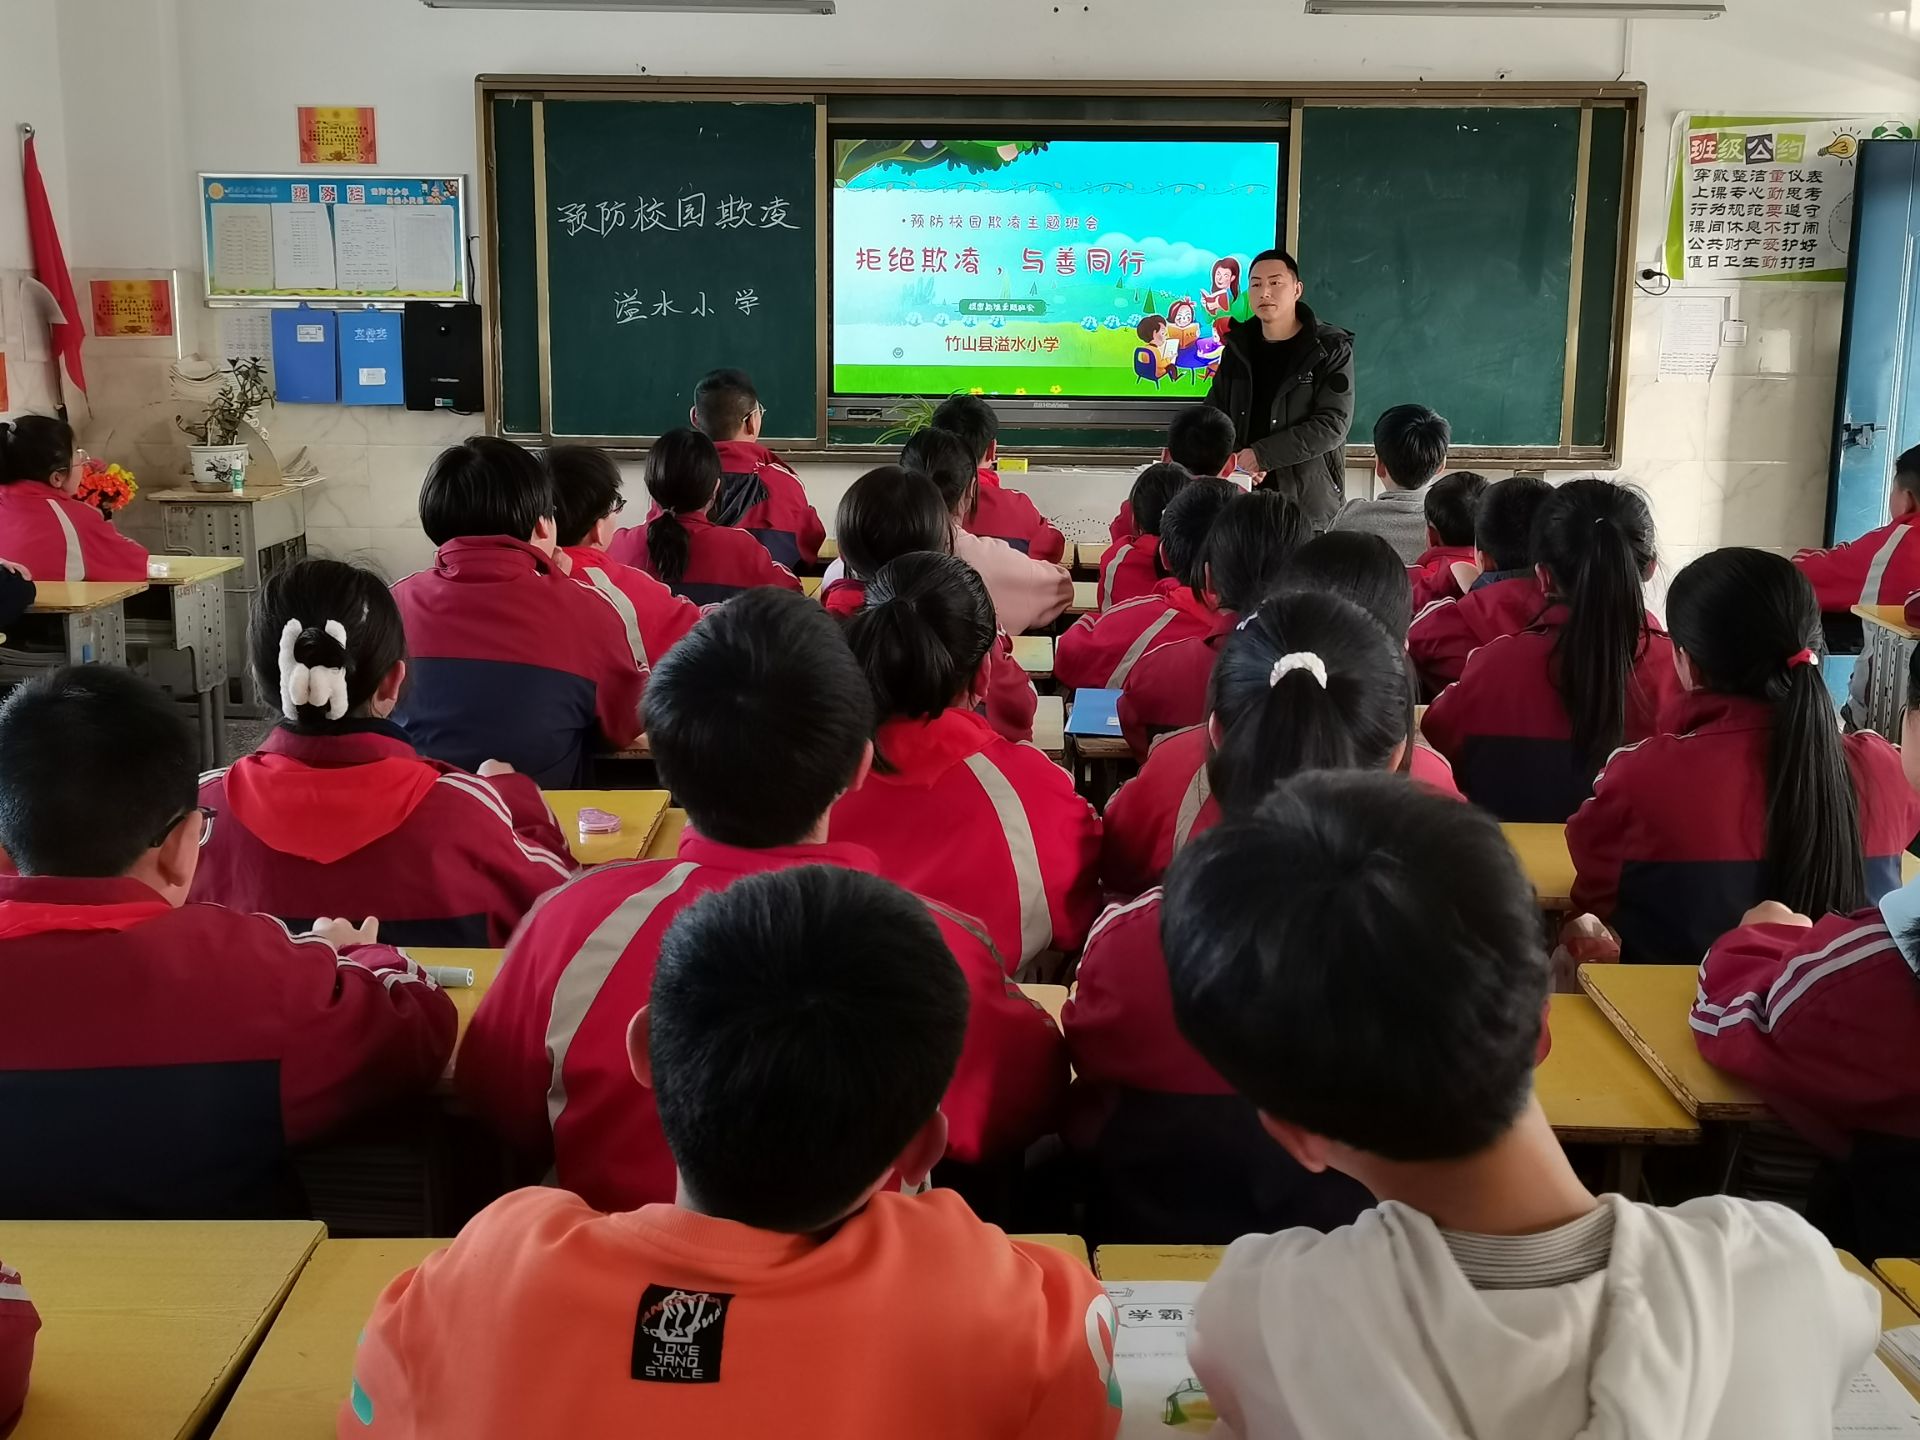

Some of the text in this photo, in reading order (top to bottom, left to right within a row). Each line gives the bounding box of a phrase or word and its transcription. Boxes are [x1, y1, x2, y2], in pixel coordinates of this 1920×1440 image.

[1690, 136, 1804, 161] 班级公约
[1693, 168, 1824, 183] 穿戴整洁重仪表
[1692, 186, 1823, 201] 上课专心勤思考
[557, 192, 801, 238] 预防校园欺凌
[1690, 203, 1821, 218] 行为规范要遵守
[1689, 220, 1819, 235] 课间休息不打闹
[1688, 237, 1818, 252] 公共财产爱护好
[1687, 255, 1816, 269] 值日卫生勤打扫
[614, 288, 760, 324] 溢水小学
[945, 335, 1060, 352] 竹山县溢水小学
[653, 1343, 700, 1356] LOVE
[645, 1366, 704, 1379] STYLE
